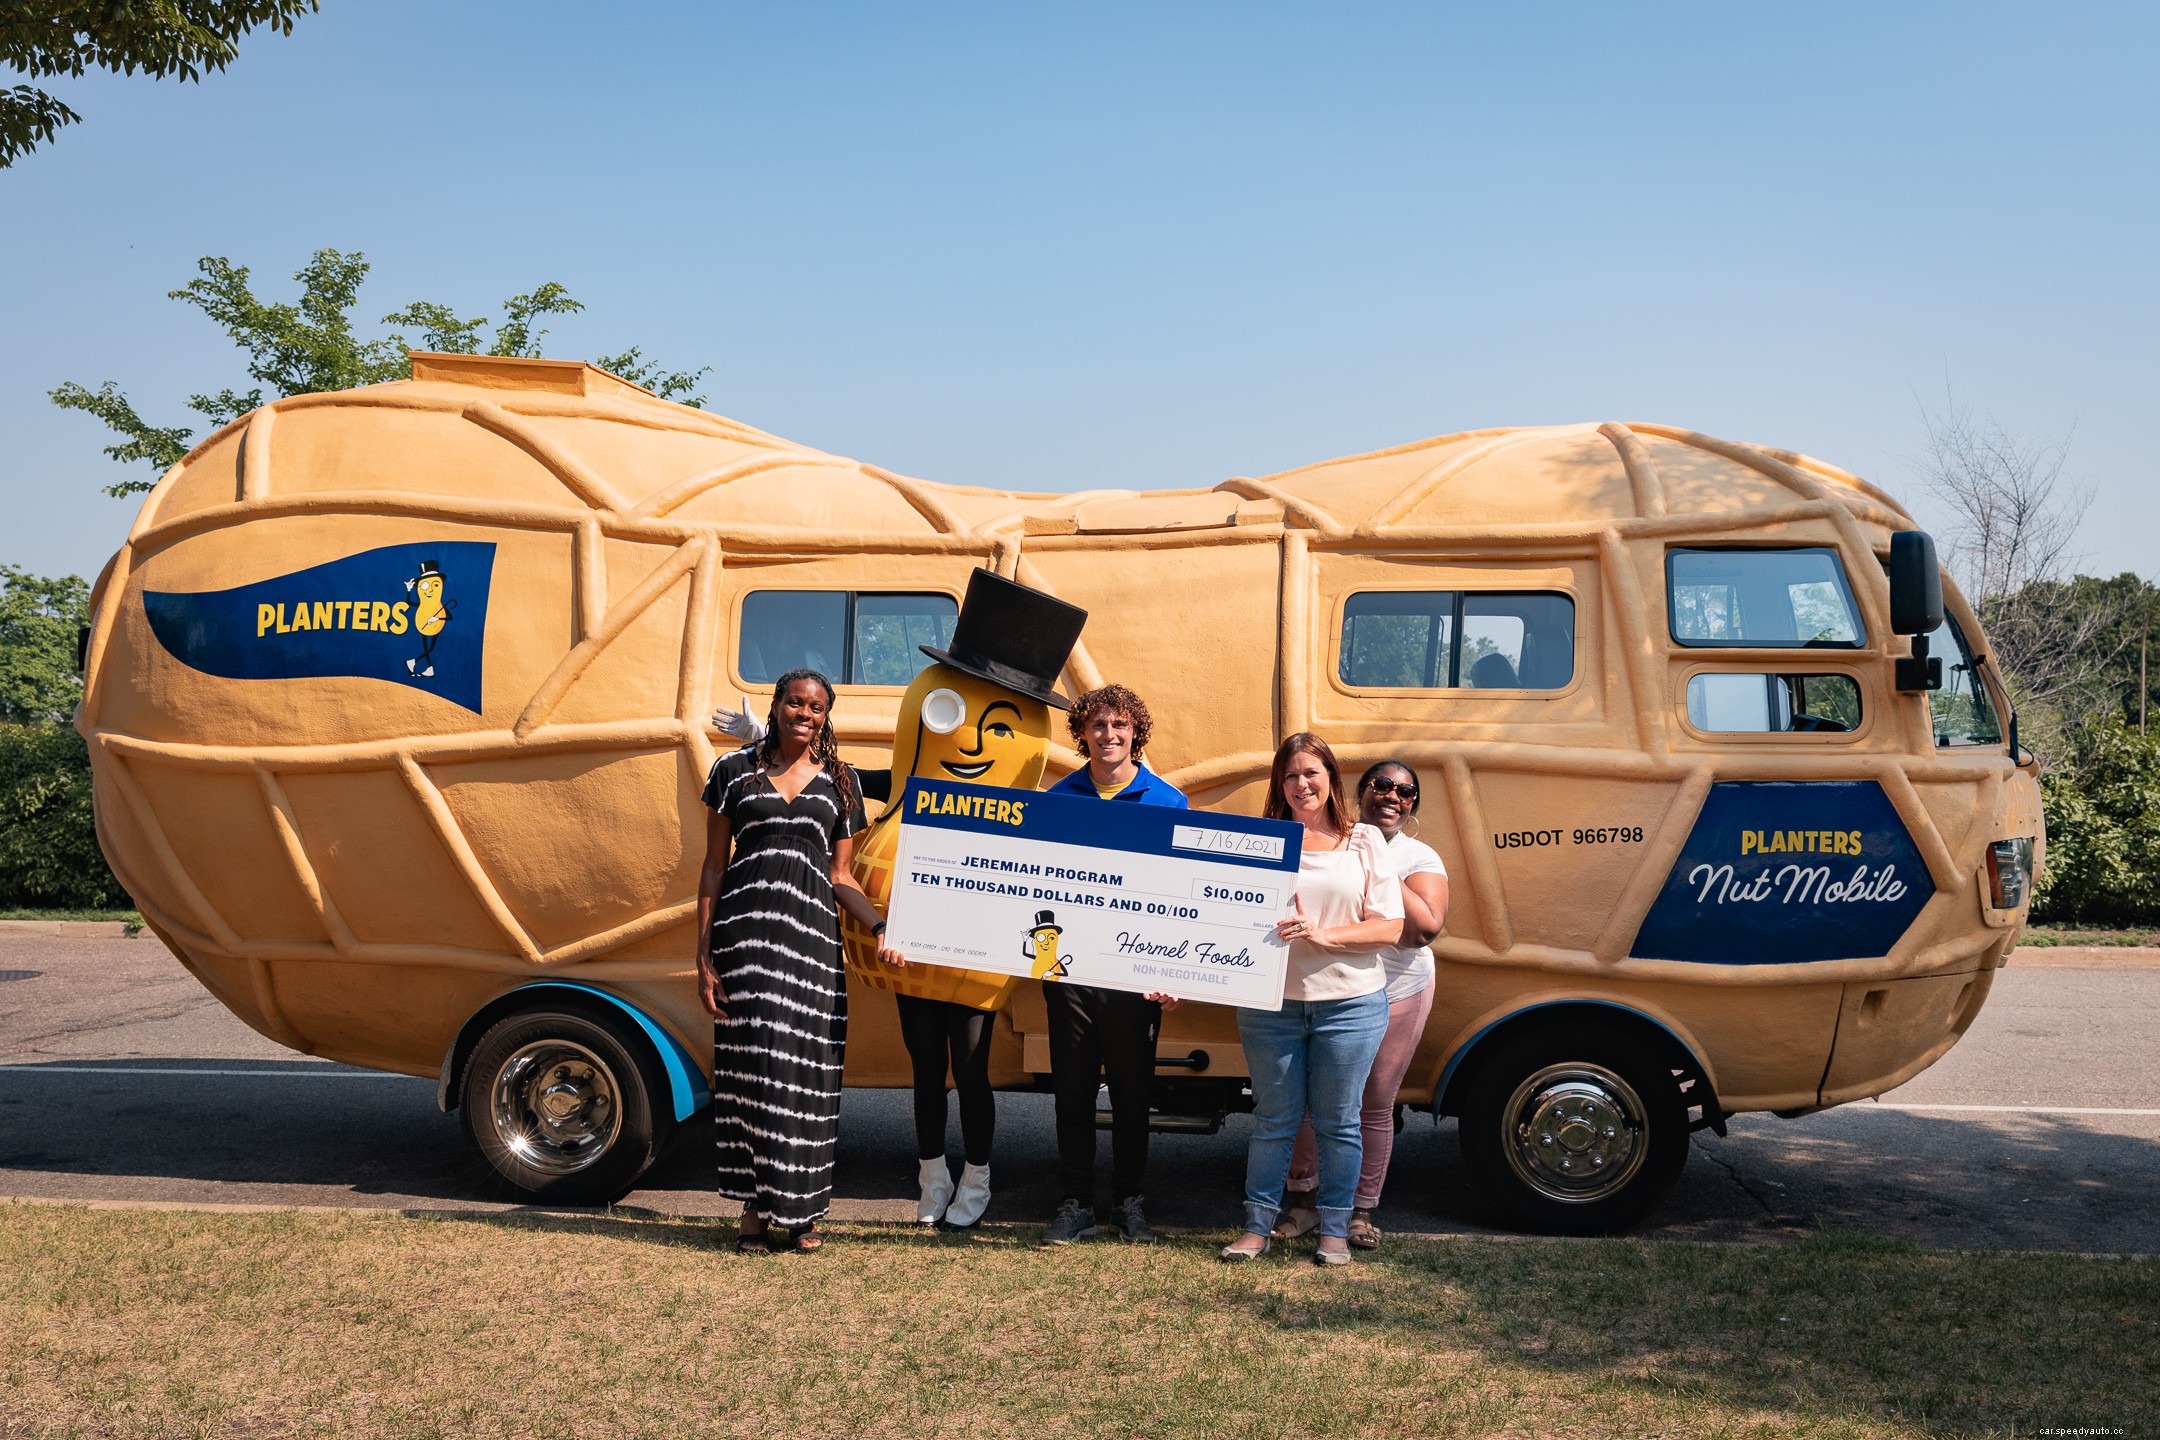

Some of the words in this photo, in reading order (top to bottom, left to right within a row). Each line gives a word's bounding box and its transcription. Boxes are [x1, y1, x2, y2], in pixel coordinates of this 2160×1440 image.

[257, 601, 410, 638] PLANTERS
[915, 790, 1026, 826] PLANTERS
[1188, 828, 1278, 856] 7/16/2021
[1494, 829, 1564, 849] USDOT
[1572, 826, 1644, 845] 966798
[1741, 830, 1862, 856] PLANTERS
[961, 856, 1041, 876] JEREMIAH
[1044, 866, 1123, 886] PROGRAM
[1688, 863, 1772, 904] Nut
[1774, 863, 1908, 904] Mobile
[911, 872, 941, 886] TEN
[944, 876, 1029, 897] THOUSAND
[1032, 887, 1105, 907] DOLLARS
[1108, 898, 1142, 912] AND
[1146, 903, 1199, 920] 00/100
[1203, 885, 1265, 904] $10,000
[1116, 931, 1189, 959] Hormel
[1194, 942, 1255, 968] Foods
[1132, 963, 1229, 985] NON-NEGOTIABLE
